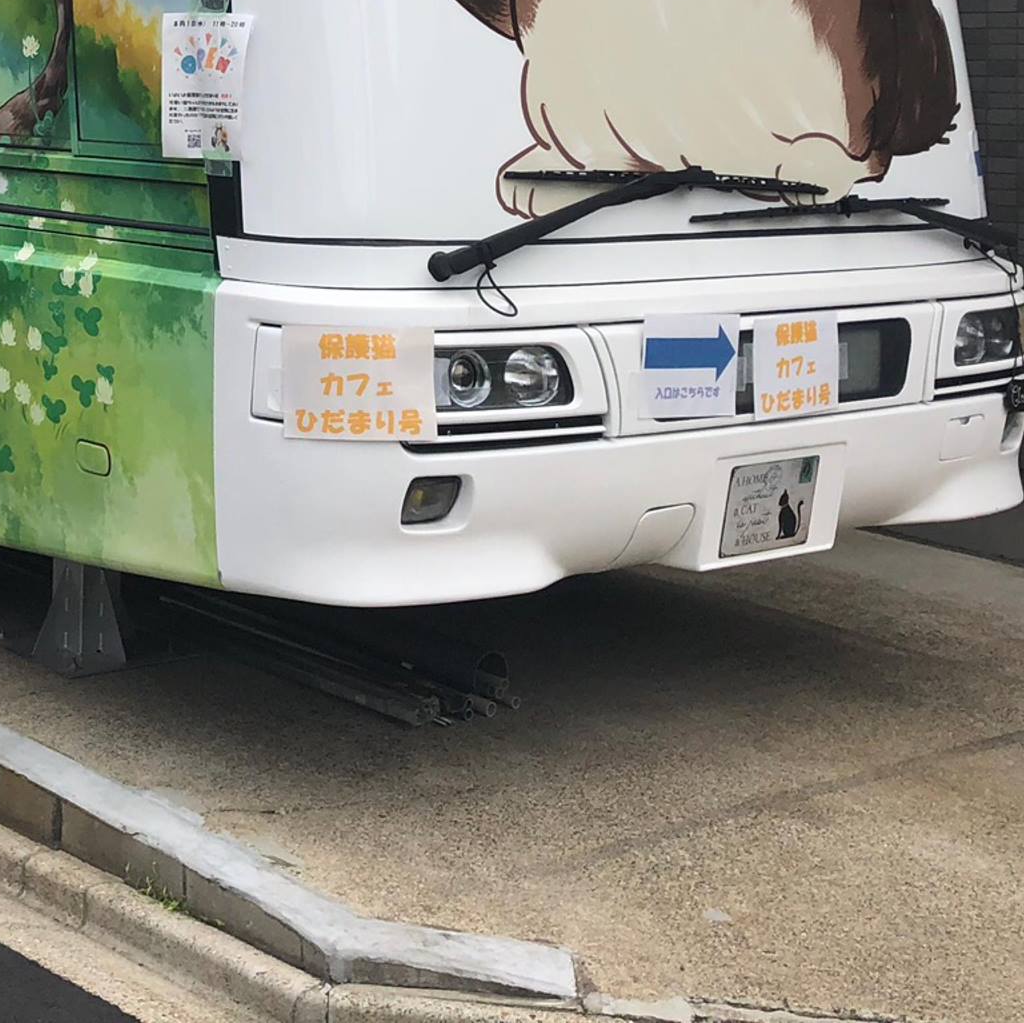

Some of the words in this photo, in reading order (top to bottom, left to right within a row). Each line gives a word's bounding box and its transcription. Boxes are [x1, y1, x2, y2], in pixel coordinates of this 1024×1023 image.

[181, 47, 231, 75] OPEN
[319, 333, 397, 361] 保護猫
[775, 320, 818, 347] 保護猫
[776, 355, 817, 379] カフェ
[320, 372, 394, 397] カフェ
[655, 386, 721, 400] 入口はこちらです
[761, 383, 832, 414] ひだまり号
[295, 408, 423, 436] ひだまり号
[740, 503, 760, 516] CAT
